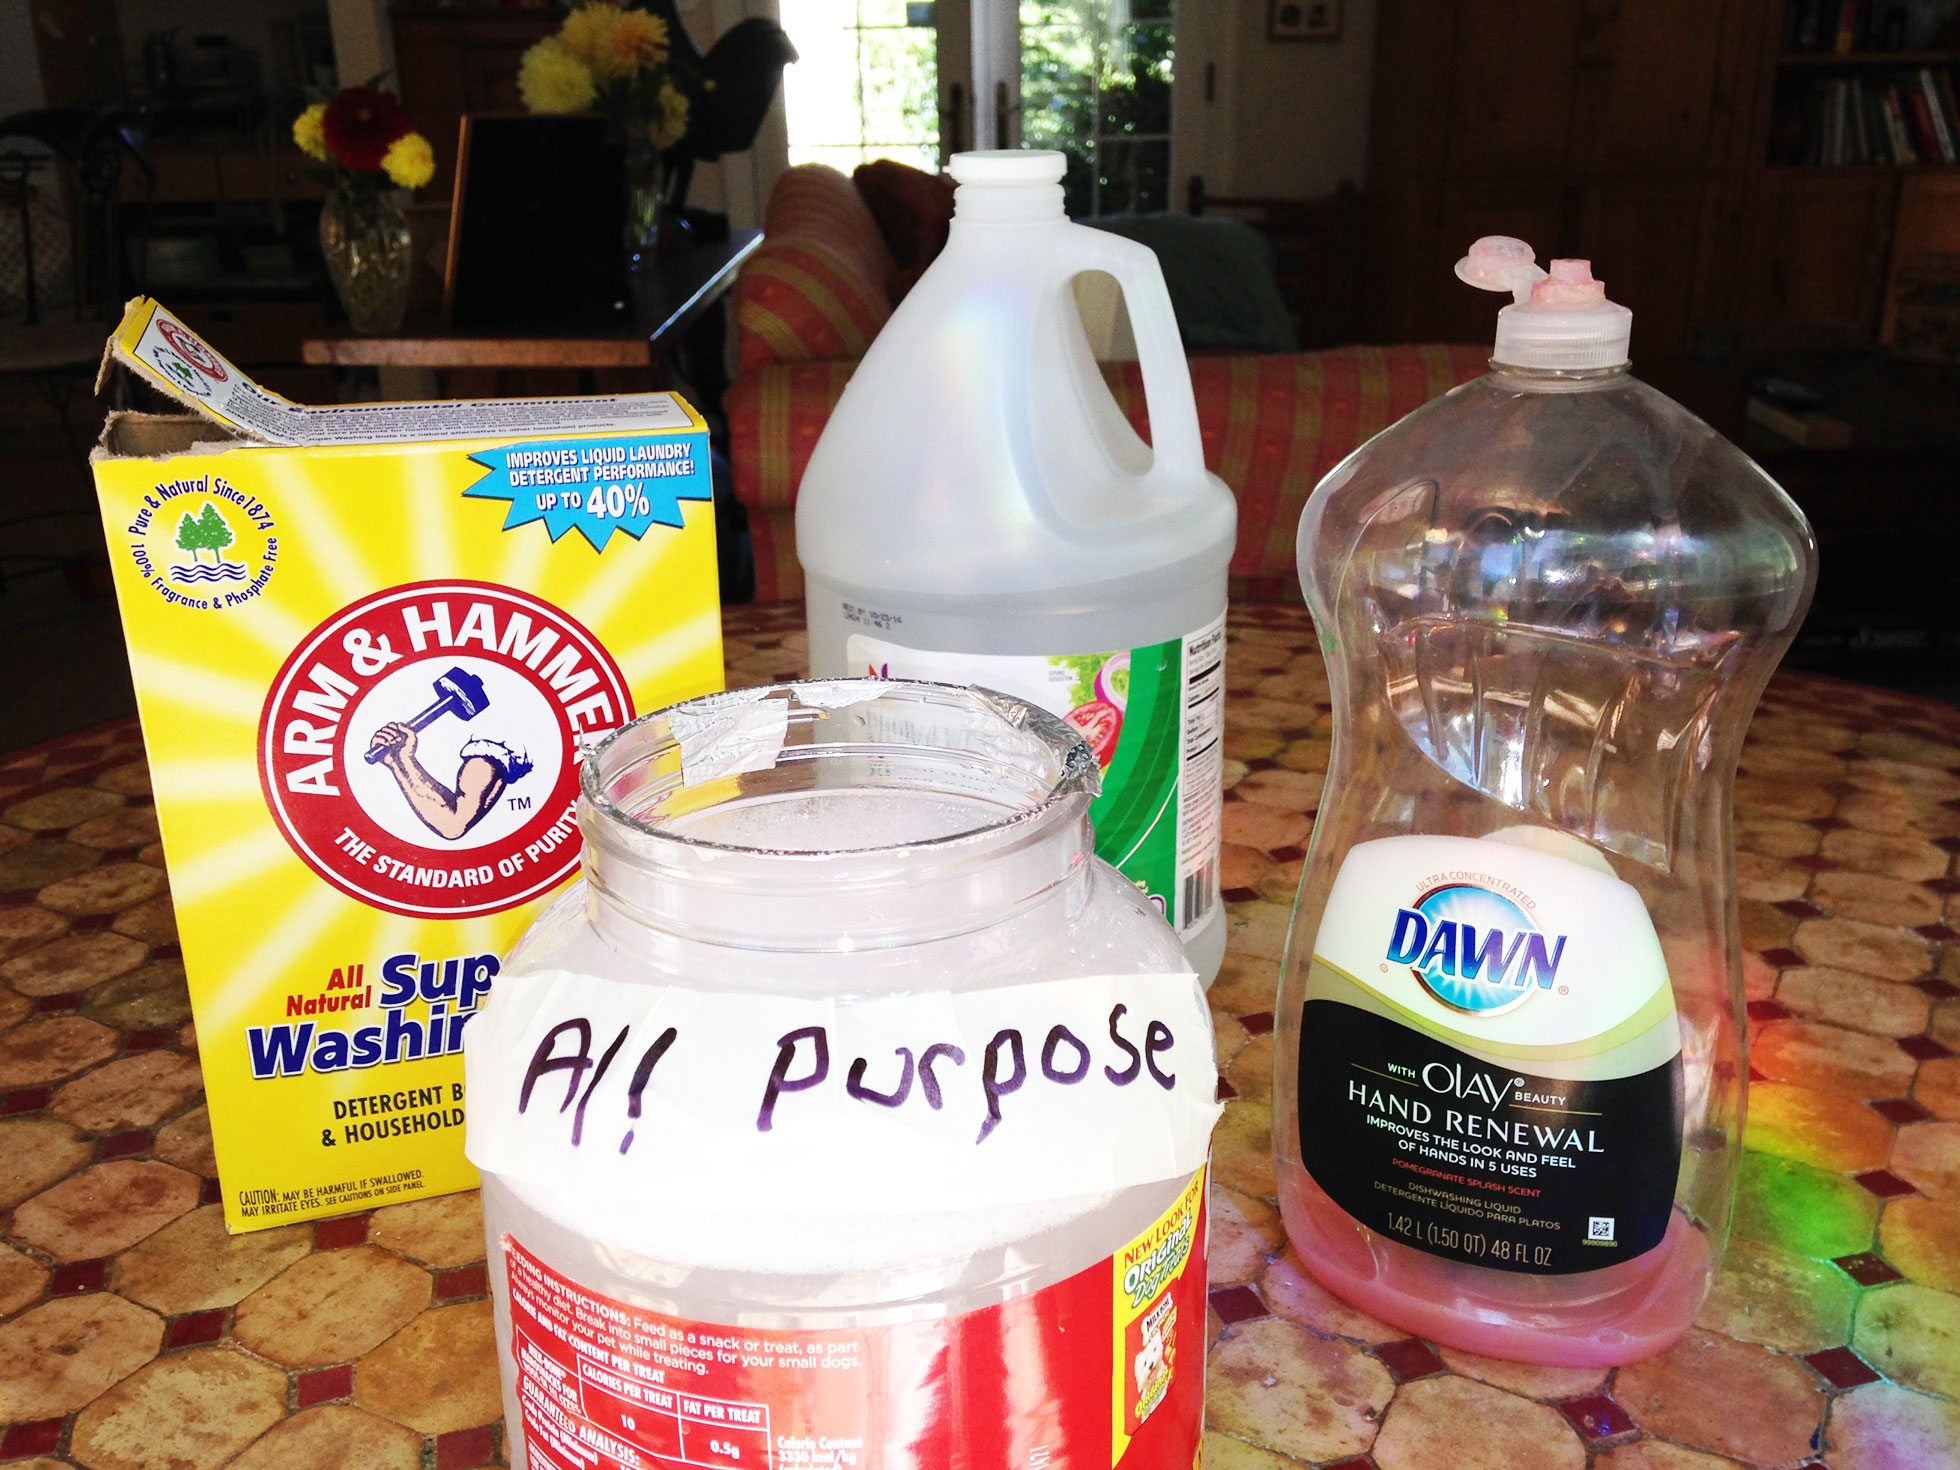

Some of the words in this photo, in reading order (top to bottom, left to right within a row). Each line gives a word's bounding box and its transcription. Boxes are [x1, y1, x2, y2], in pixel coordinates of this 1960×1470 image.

[506, 449, 578, 469] IMPROVES
[581, 446, 626, 466] LIQUID
[629, 443, 692, 463] LAUNDRY
[509, 466, 590, 487] DETERGENT
[593, 460, 695, 482] PERFORMANCE!
[128, 508, 153, 536] Pure
[144, 495, 161, 509] &
[155, 474, 208, 501] Natural
[213, 478, 246, 505] Since
[243, 496, 275, 530] 1874
[536, 492, 557, 511] UP
[561, 491, 582, 509] TO
[586, 482, 650, 519] 40%
[131, 543, 155, 578] 100%
[151, 577, 208, 610] Fragrance
[213, 597, 223, 610] &
[225, 564, 274, 607] Phosphate
[263, 537, 278, 562] Free
[283, 662, 359, 797] ARM
[342, 627, 404, 677] &
[507, 796, 532, 811] TM
[334, 826, 377, 866] THE
[372, 854, 495, 890] STANDARD
[499, 852, 526, 880] OF
[1416, 872, 1449, 892] ULTRA
[1449, 871, 1537, 910] CONCENTRATED
[1386, 908, 1567, 989] DAWN
[326, 964, 364, 991] All
[286, 985, 372, 1017] Natural
[333, 1085, 443, 1121] DETERGENT
[1387, 1062, 1416, 1079] WITH
[1515, 1091, 1567, 1106] BEAUTY
[321, 1129, 337, 1147] &
[344, 1108, 465, 1144] HOUSEHOLD
[1349, 1080, 1432, 1125] HAND
[1446, 1109, 1605, 1153] RENEWAL
[1366, 1114, 1430, 1142] IMPROVES
[1433, 1134, 1460, 1151] THE
[1463, 1141, 1502, 1159] LOOK
[1505, 1151, 1538, 1165] AND
[1541, 1155, 1576, 1169] FEEL
[1398, 1139, 1416, 1152] OF
[1419, 1146, 1467, 1166] HANDS
[1470, 1157, 1485, 1170] IN
[1488, 1161, 1497, 1172] 5
[1500, 1164, 1538, 1178] USES
[239, 1188, 280, 1206] CAUTION:
[282, 1190, 300, 1202] MAY
[303, 1188, 315, 1198] BE
[316, 1181, 358, 1196] HARMFUL
[359, 1179, 368, 1188] IF
[369, 1169, 425, 1187] SWALLOWED.
[1392, 1158, 1465, 1185] POMEGRANATE
[1467, 1178, 1506, 1192] SPLASH
[1508, 1185, 1542, 1198] SCENT
[241, 1206, 260, 1217] MAY
[262, 1201, 298, 1216] IRRITATE
[300, 1199, 323, 1210] EYES.
[325, 1196, 338, 1206] SEE
[338, 1190, 373, 1204] CAUTIONS
[374, 1188, 385, 1197] ON
[386, 1184, 401, 1195] SIDE
[1374, 1181, 1438, 1208] DETERGENTE
[1486, 1211, 1516, 1223] PARA
[1518, 1217, 1561, 1231] PLATOS
[1408, 1182, 1482, 1208] DISHWASHING
[1484, 1201, 1522, 1215] LIQUID
[1124, 1234, 1154, 1269] NEW
[1156, 1203, 1184, 1244] LOOK
[1185, 1180, 1199, 1210] FOR
[1388, 1212, 1412, 1237] 1.42
[1416, 1222, 1423, 1240] L
[1427, 1221, 1459, 1249] (1.50
[1464, 1232, 1487, 1257] QT)
[1491, 1239, 1511, 1260] 48
[1515, 1243, 1529, 1263] FL
[1534, 1246, 1553, 1266] OZ
[509, 1245, 543, 1281] EEDING
[543, 1273, 631, 1327] INSTRUCTIONS:
[633, 1317, 666, 1337] Feed
[669, 1328, 685, 1342] as
[687, 1332, 696, 1344] a
[699, 1333, 741, 1350] snack
[743, 1341, 760, 1352] or
[763, 1340, 802, 1355] treat,
[806, 1342, 824, 1354] as
[827, 1340, 859, 1358] part
[517, 1267, 522, 1276] a
[522, 1268, 552, 1302] healthy
[552, 1294, 574, 1315] diet.
[575, 1307, 606, 1331] Break
[608, 1323, 632, 1341] into
[633, 1330, 667, 1351] small
[669, 1341, 714, 1362] pieces
[717, 1350, 738, 1364] for
[741, 1355, 774, 1369] your
[778, 1354, 817, 1369] small
[821, 1356, 862, 1371] dogs.
[511, 1271, 535, 1300] Always
[536, 1295, 570, 1326] monitor
[571, 1320, 595, 1338] your
[597, 1331, 617, 1349] pet
[618, 1341, 650, 1361] while
[653, 1350, 709, 1376] treating.
[512, 1288, 537, 1320] CALORIE
[538, 1312, 553, 1332] AND
[553, 1325, 568, 1343] FAT
[568, 1334, 609, 1363] CONTENT
[611, 1353, 631, 1373] PER
[632, 1362, 665, 1384] TREAT
[562, 1383, 578, 1403] FOR
[582, 1363, 622, 1391] CALORIES
[623, 1381, 642, 1400] PER
[643, 1390, 673, 1410] TREAT
[523, 1376, 577, 1434] GUARANTEED
[579, 1426, 640, 1465] ANALYSIS:
[621, 1415, 636, 1430] 10
[683, 1401, 701, 1415] FAT
[704, 1405, 725, 1419] PER
[727, 1408, 761, 1424] TREAT
[710, 1440, 740, 1459] 0.5g
[776, 1436, 816, 1450] Calorie
[818, 1436, 862, 1450] Content
